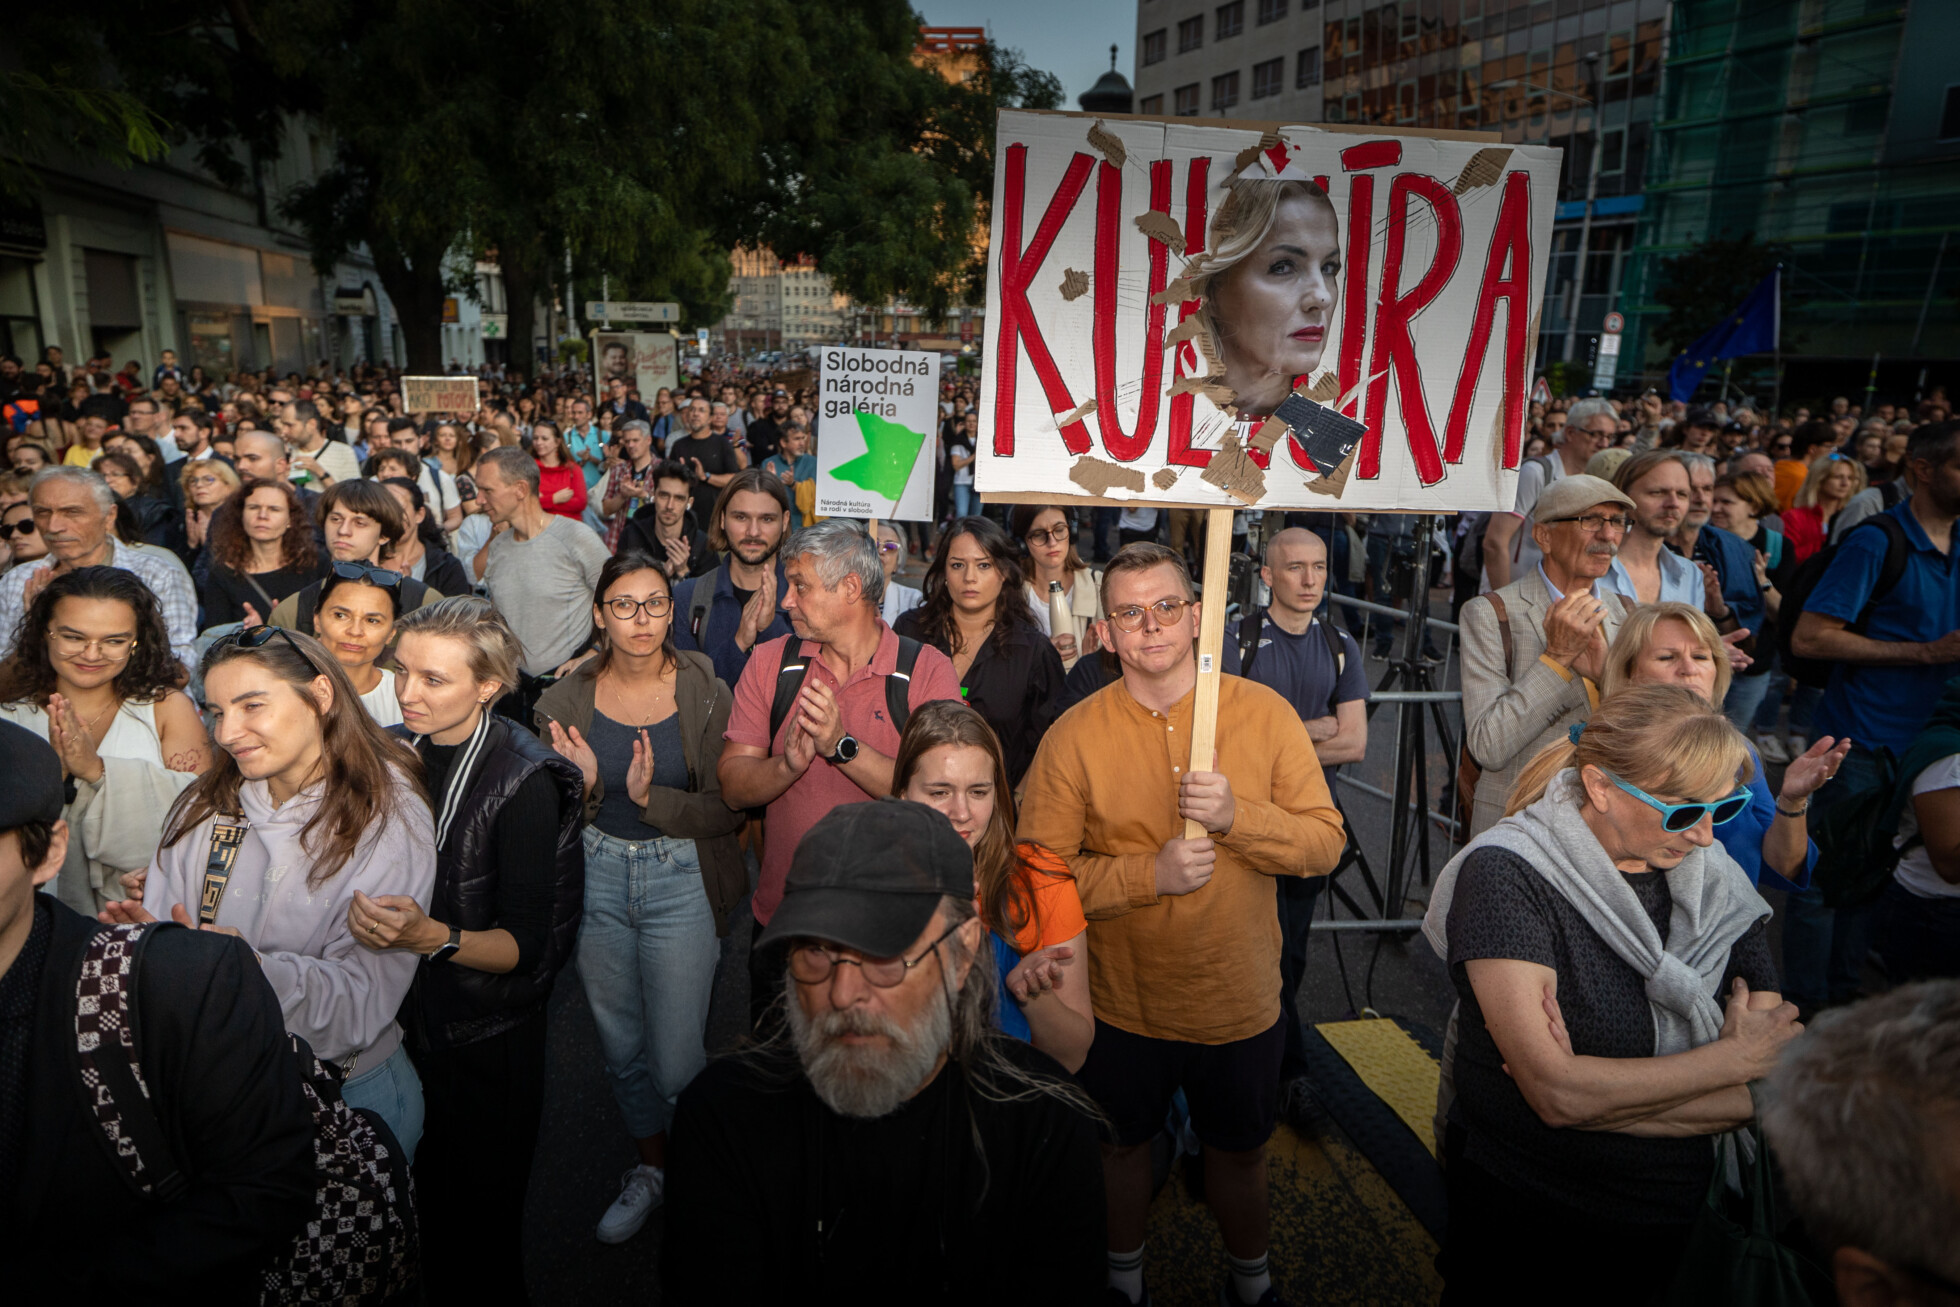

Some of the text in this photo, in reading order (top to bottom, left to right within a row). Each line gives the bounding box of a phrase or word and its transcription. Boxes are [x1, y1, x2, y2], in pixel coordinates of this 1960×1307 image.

[826, 351, 929, 375] Slobodná
[826, 374, 914, 396] národná
[825, 396, 897, 418] galéria
